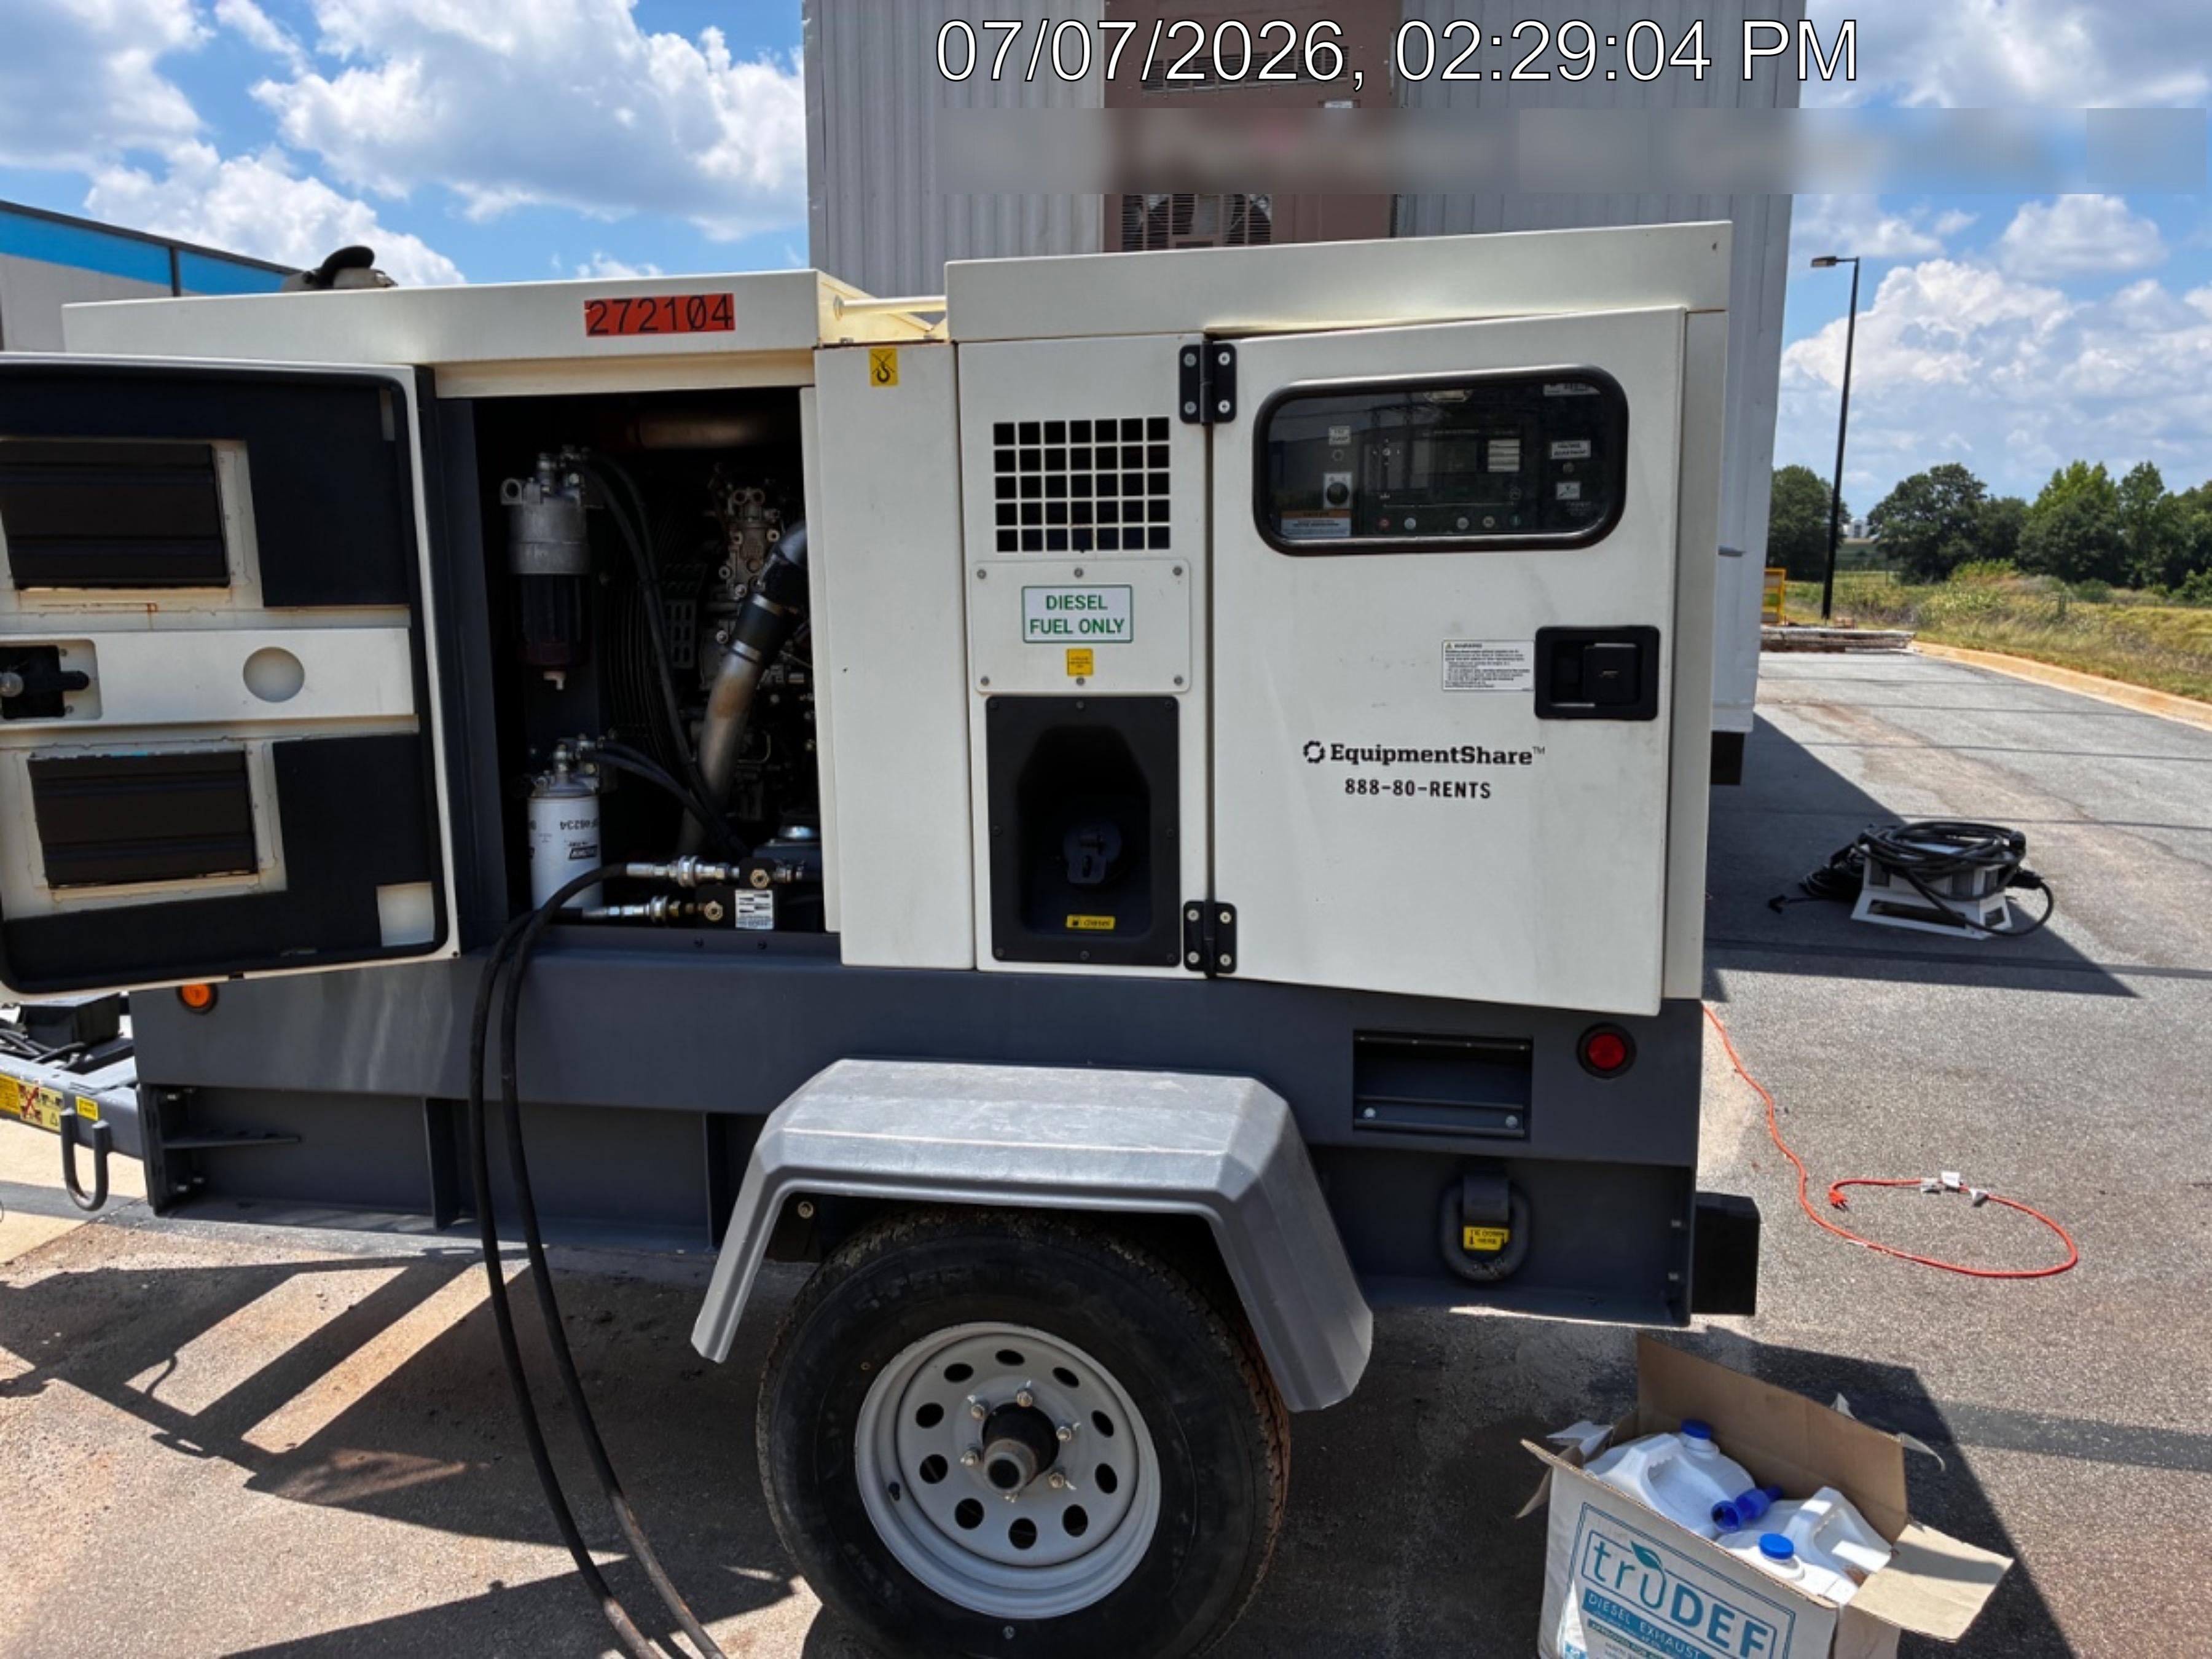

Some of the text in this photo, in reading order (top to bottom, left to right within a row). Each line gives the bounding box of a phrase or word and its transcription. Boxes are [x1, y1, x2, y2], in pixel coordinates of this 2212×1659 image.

[588, 294, 734, 335] 272104
[1046, 595, 1108, 611] DIESEL
[1030, 618, 1125, 635] FUEL ONLY
[1344, 777, 1492, 799] 888-80-RENTS
[1588, 1592, 1630, 1625] DIESEL
[1639, 1621, 1701, 1659] EXHAUST
